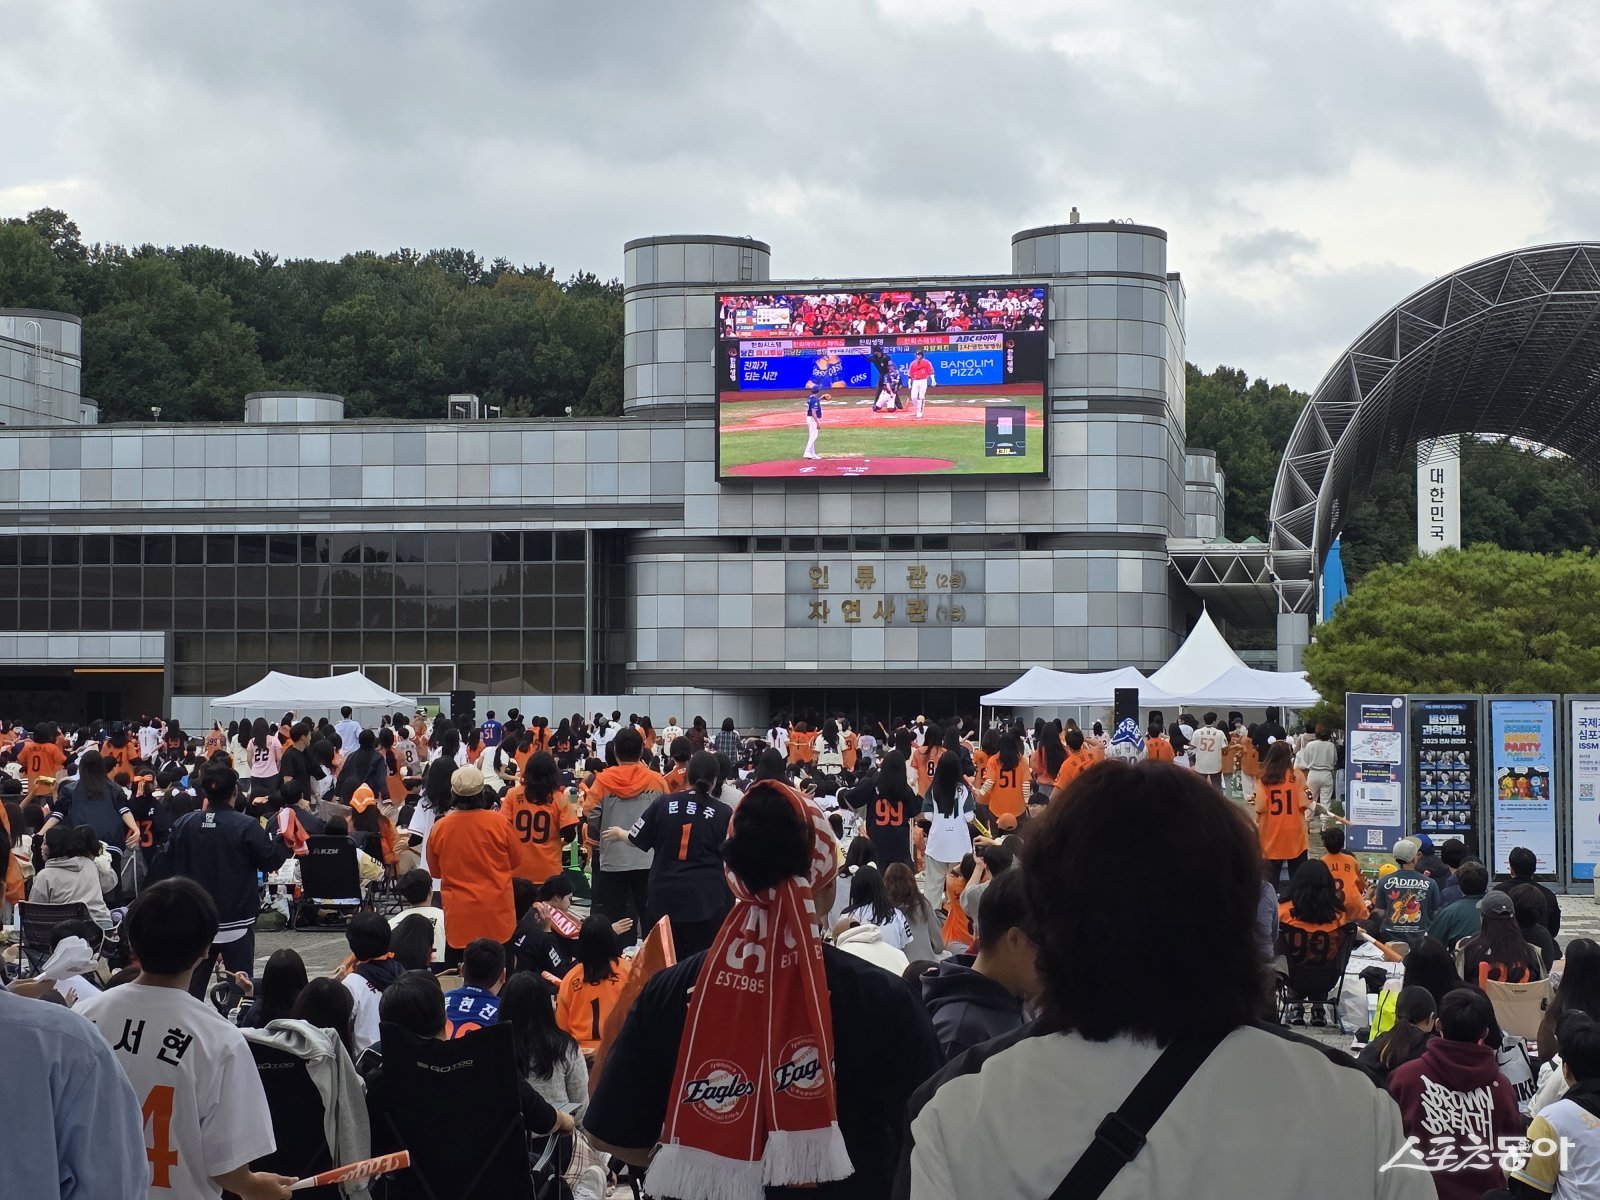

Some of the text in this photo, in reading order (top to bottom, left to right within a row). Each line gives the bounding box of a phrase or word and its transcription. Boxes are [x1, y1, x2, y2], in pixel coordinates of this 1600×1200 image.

[751, 341, 783, 349] 한화시스템
[859, 338, 884, 346] 한화생명
[955, 334, 998, 343] ABC 타이어
[743, 361, 768, 371] 진짜가
[950, 368, 983, 377] PIZZA
[744, 371, 778, 381] 되는 시간
[1430, 468, 1445, 541] 대한민국
[936, 570, 967, 590] (2층)
[808, 599, 929, 624] 자연사관
[1429, 714, 1460, 725] 별의별
[484, 728, 494, 739] 51
[1422, 724, 1466, 736] 과학특강!
[1200, 738, 1215, 752] 52
[1504, 742, 1542, 753] PARTY
[32, 755, 41, 772] 0
[254, 748, 269, 762] 22
[405, 749, 413, 763] 8
[927, 760, 936, 777] 8
[999, 769, 1016, 788] 51
[668, 801, 716, 819] 문동주
[1270, 789, 1293, 816] 51
[875, 798, 904, 827] 99
[516, 809, 551, 844] 99
[678, 823, 693, 861] 1
[1384, 877, 1430, 890] ADIDAS
[591, 997, 601, 1041] 1
[113, 1018, 193, 1066] 서현
[681, 1072, 756, 1105] Eagles
[1420, 1074, 1495, 1112] BROWN
[1515, 1079, 1538, 1102] IKE
[1420, 1100, 1495, 1151] BREATH
